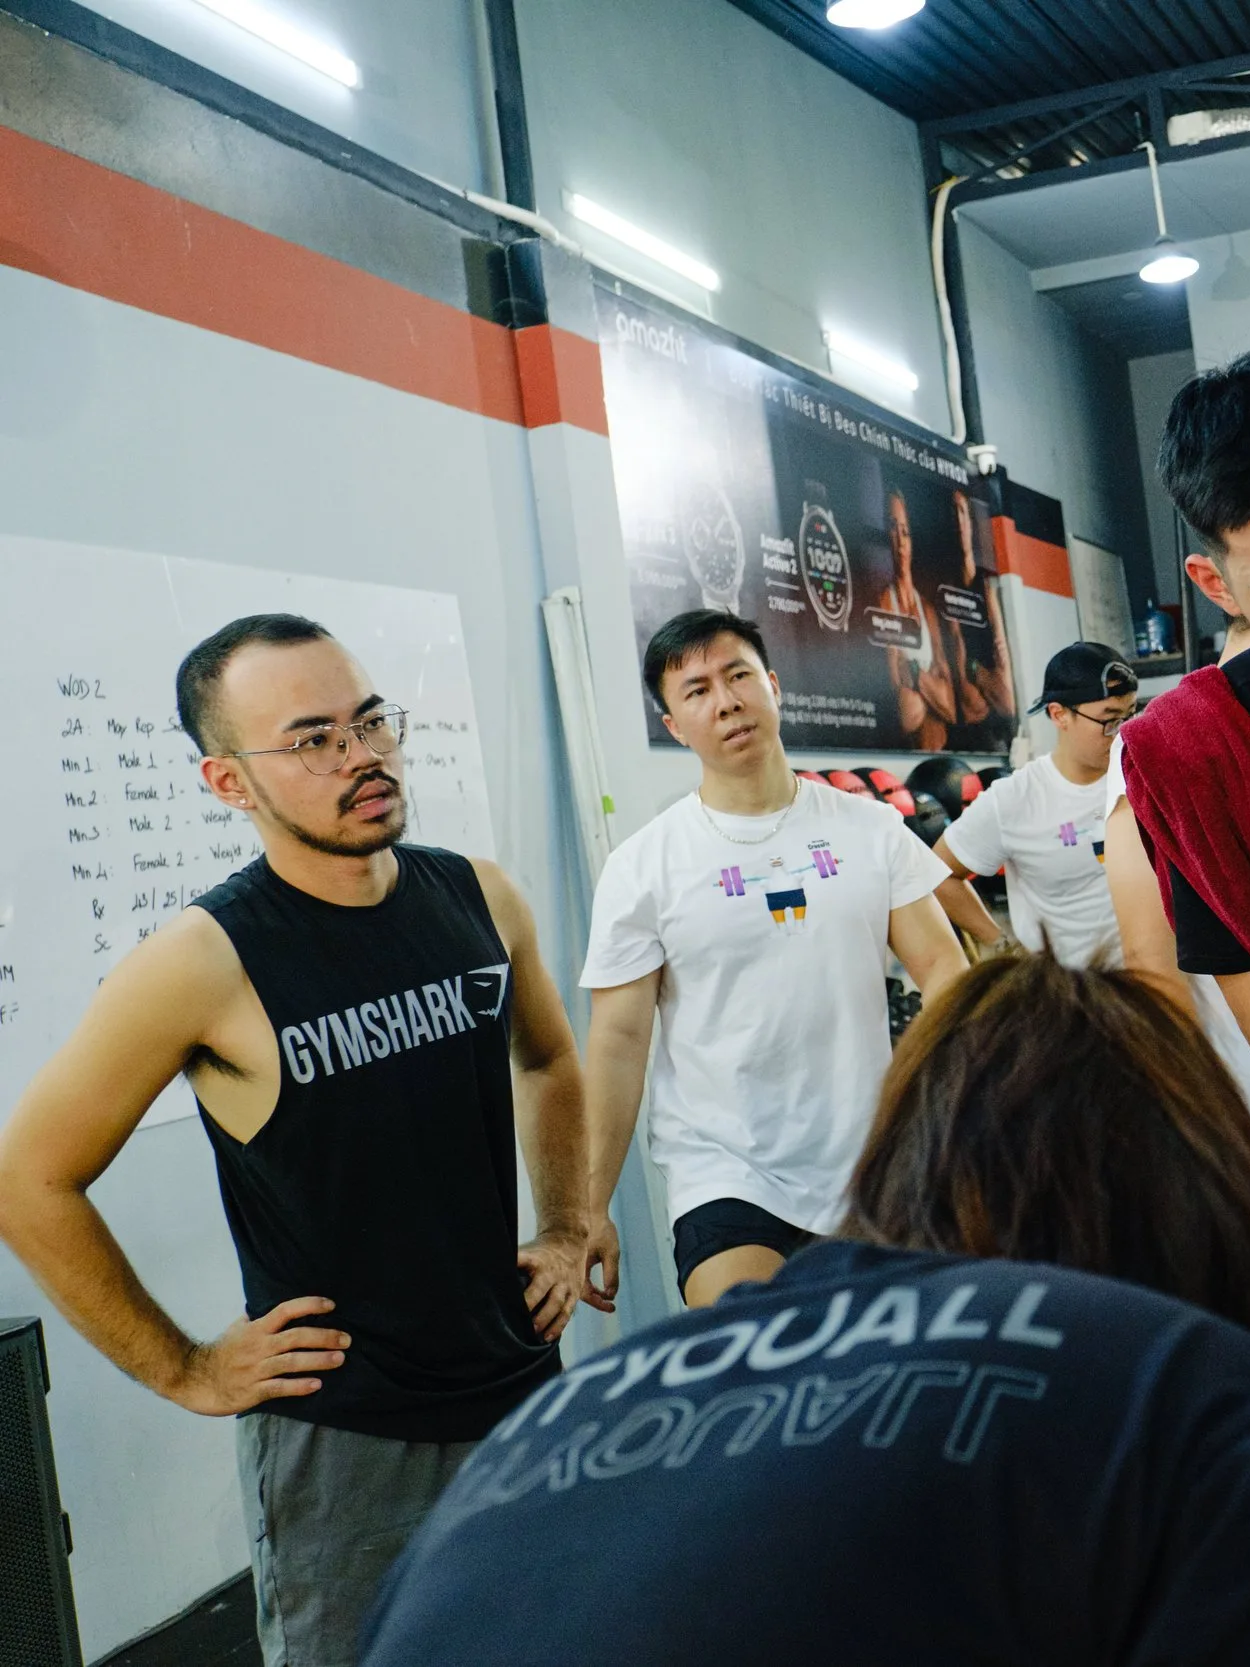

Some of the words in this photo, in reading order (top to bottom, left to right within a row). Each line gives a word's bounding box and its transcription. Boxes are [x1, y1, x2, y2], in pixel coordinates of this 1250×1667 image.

[57, 674, 90, 700] WOD
[94, 679, 106, 699] 2
[135, 716, 155, 738] Rep
[62, 757, 81, 773] Min
[118, 748, 142, 769] Male
[125, 782, 160, 801] Female
[129, 813, 155, 833] Male
[72, 865, 92, 881] Min
[133, 853, 170, 873] Female
[281, 975, 478, 1084] GYMSHARK
